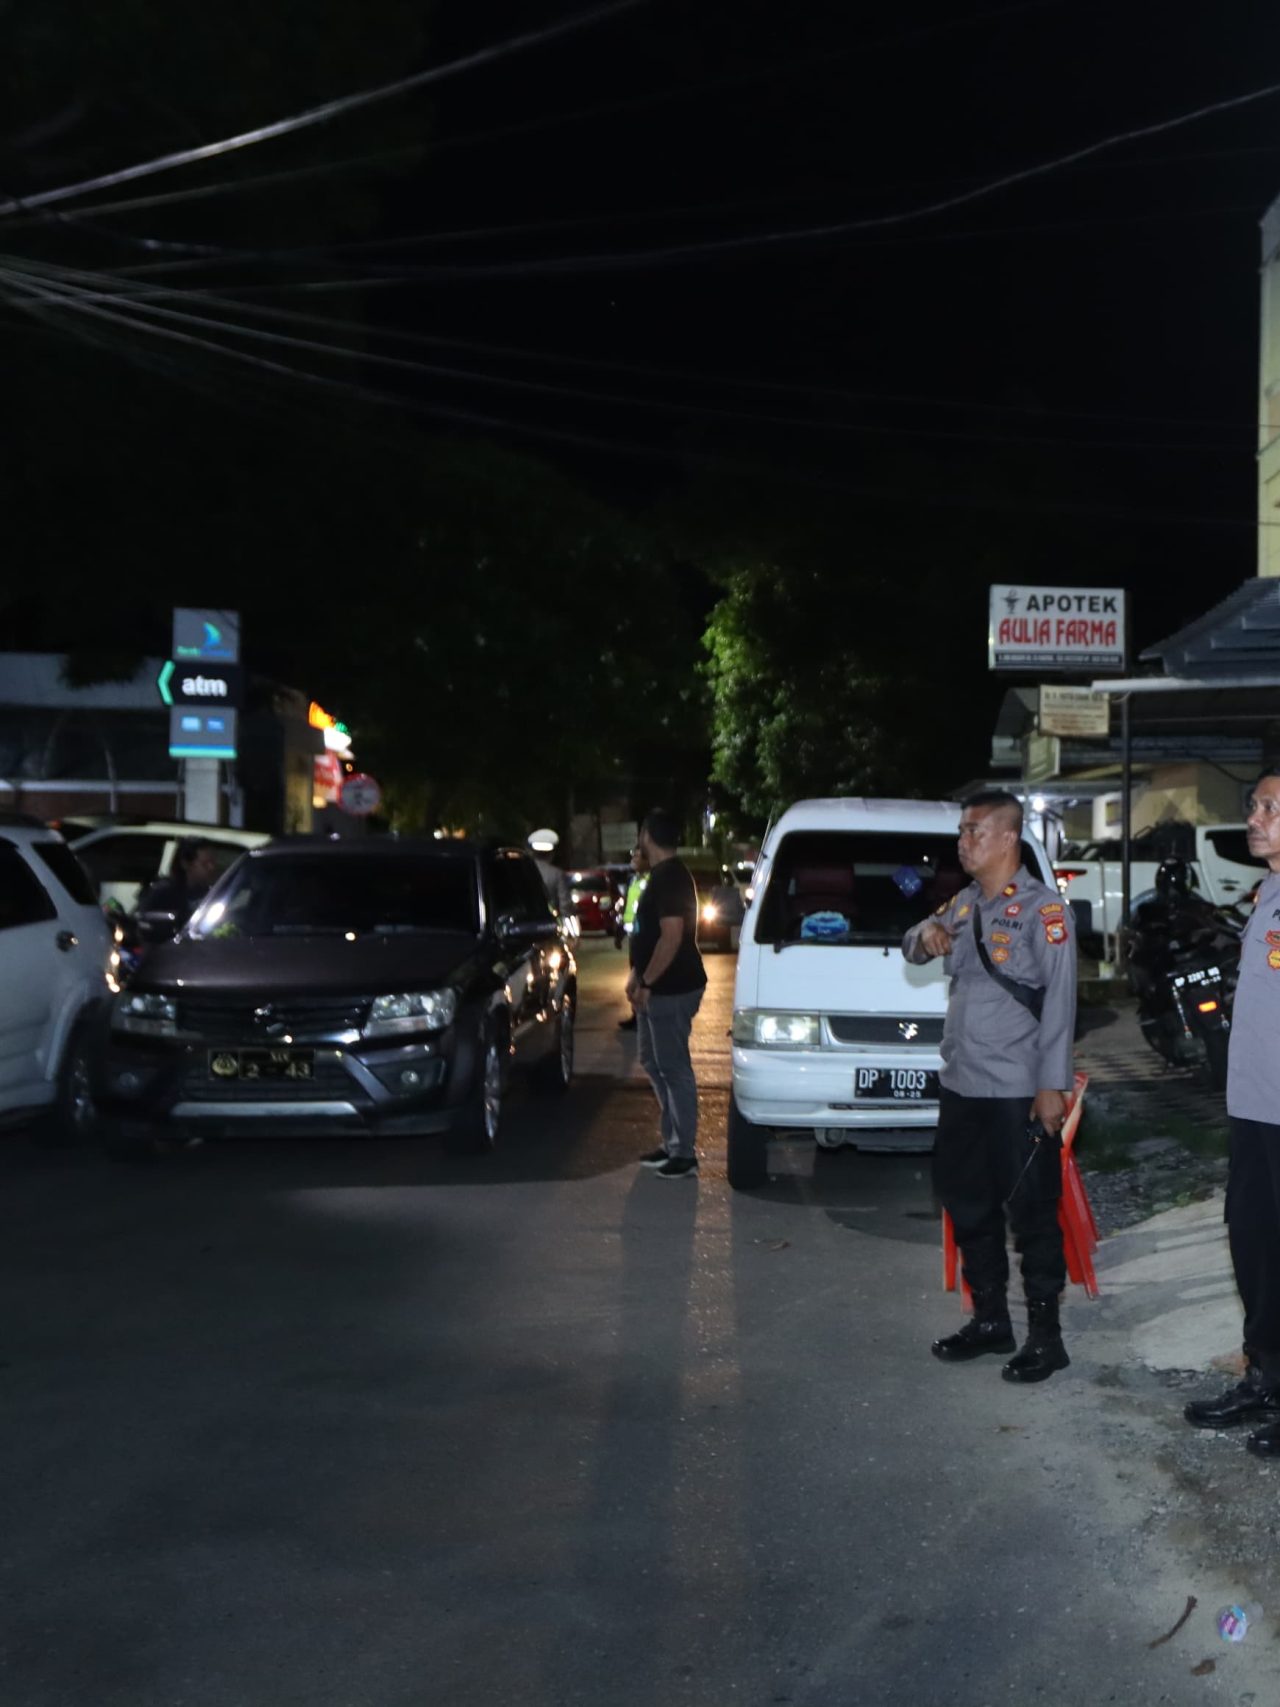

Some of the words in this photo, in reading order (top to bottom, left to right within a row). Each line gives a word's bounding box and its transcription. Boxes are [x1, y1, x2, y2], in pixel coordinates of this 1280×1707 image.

[1026, 594, 1117, 613] APOTEK
[999, 618, 1051, 645] AULIA
[1056, 618, 1116, 646] FARMA
[181, 675, 227, 696] atm
[991, 918, 1023, 931] POLRI
[859, 1069, 878, 1088] DP
[890, 1070, 926, 1089] 1003
